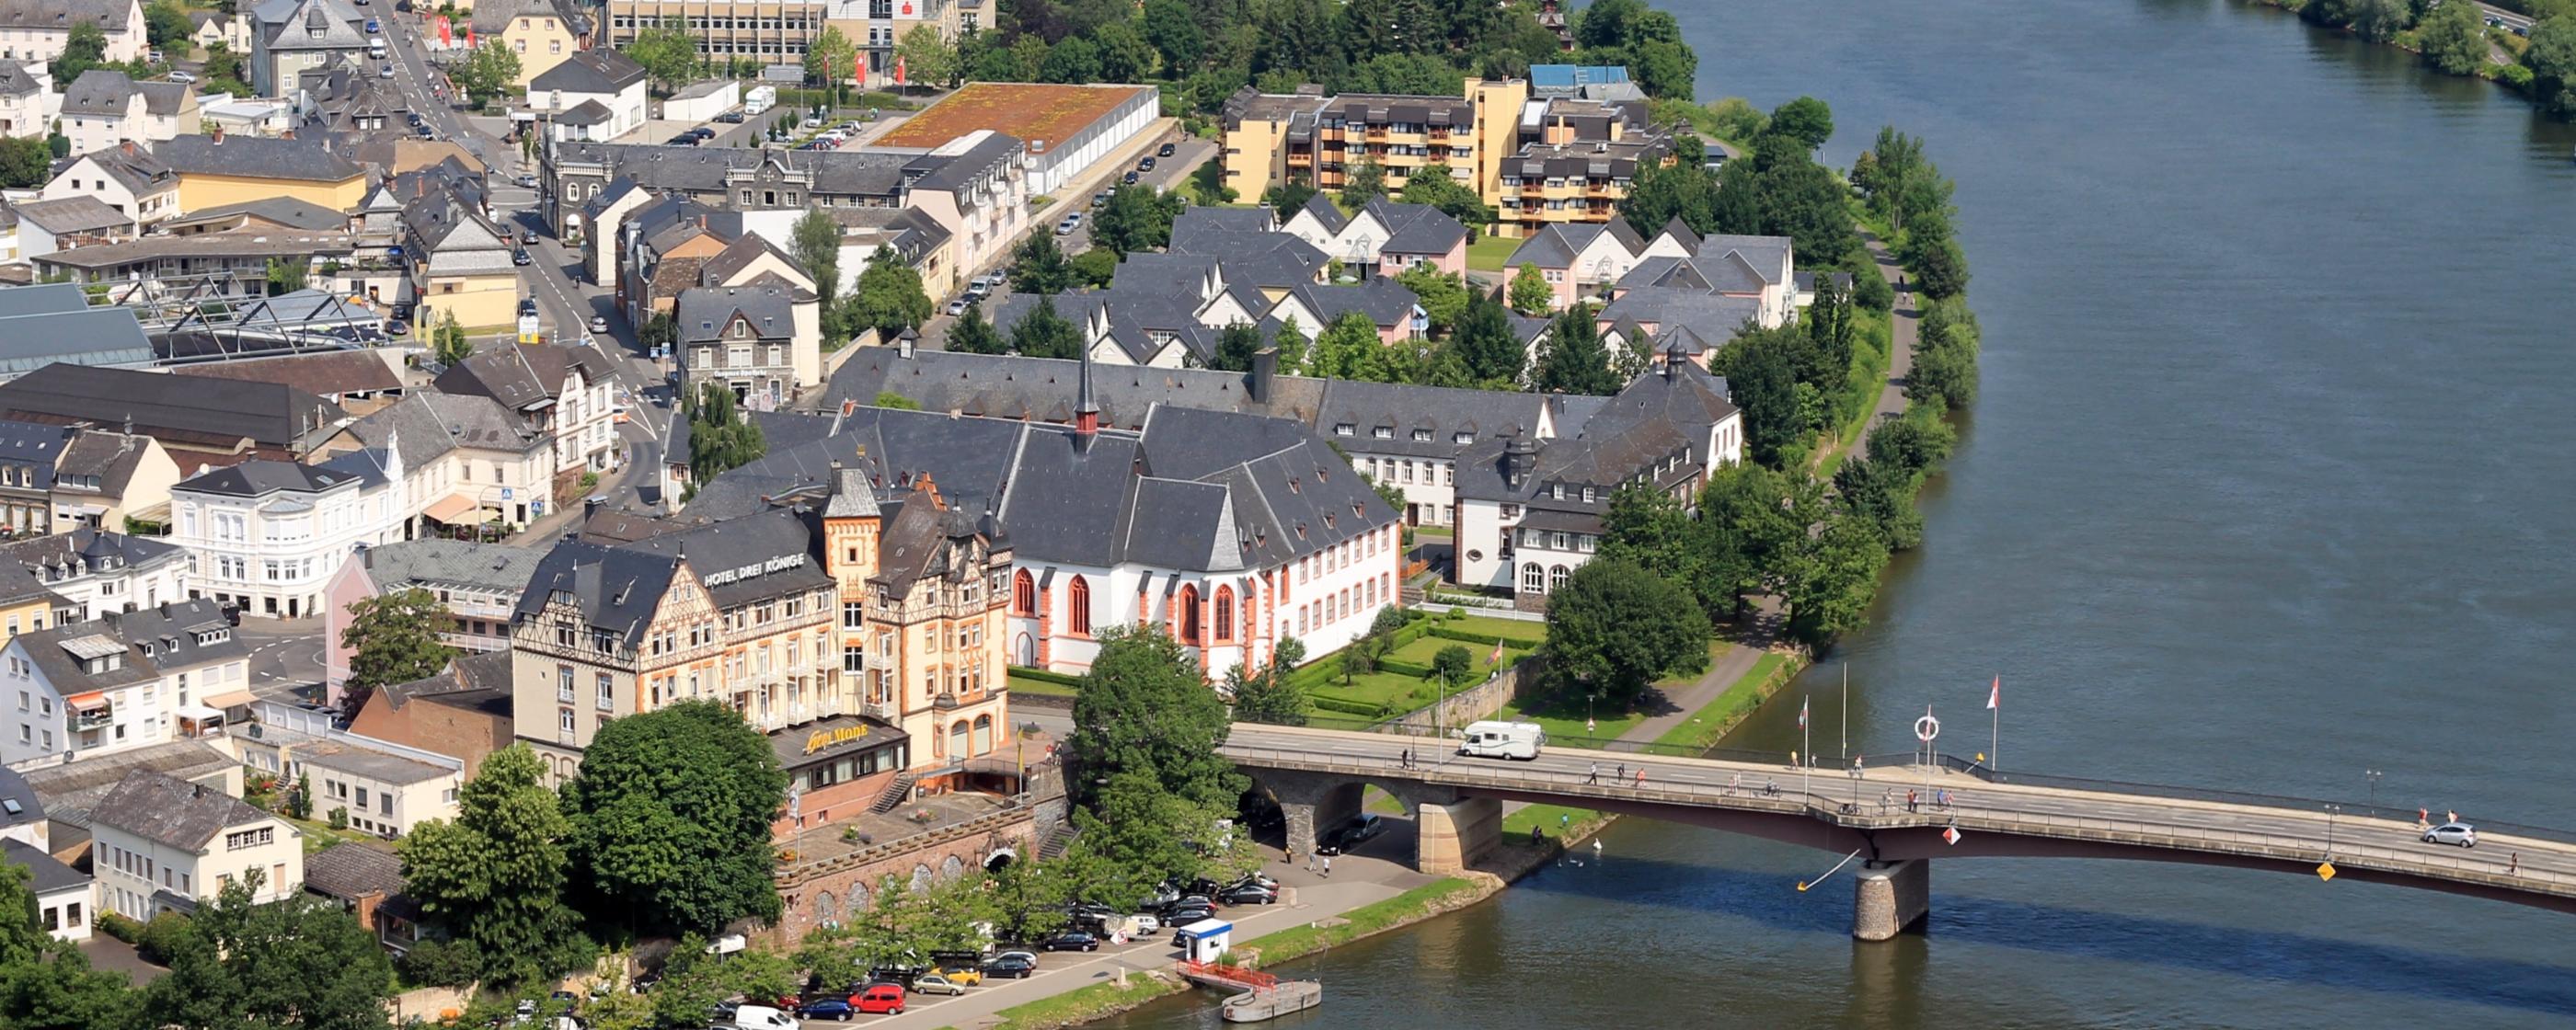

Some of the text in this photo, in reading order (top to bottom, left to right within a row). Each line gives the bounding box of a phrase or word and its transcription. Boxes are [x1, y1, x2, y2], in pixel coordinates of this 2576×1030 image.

[705, 553, 805, 587] HOTEL DREI KÖNIGE
